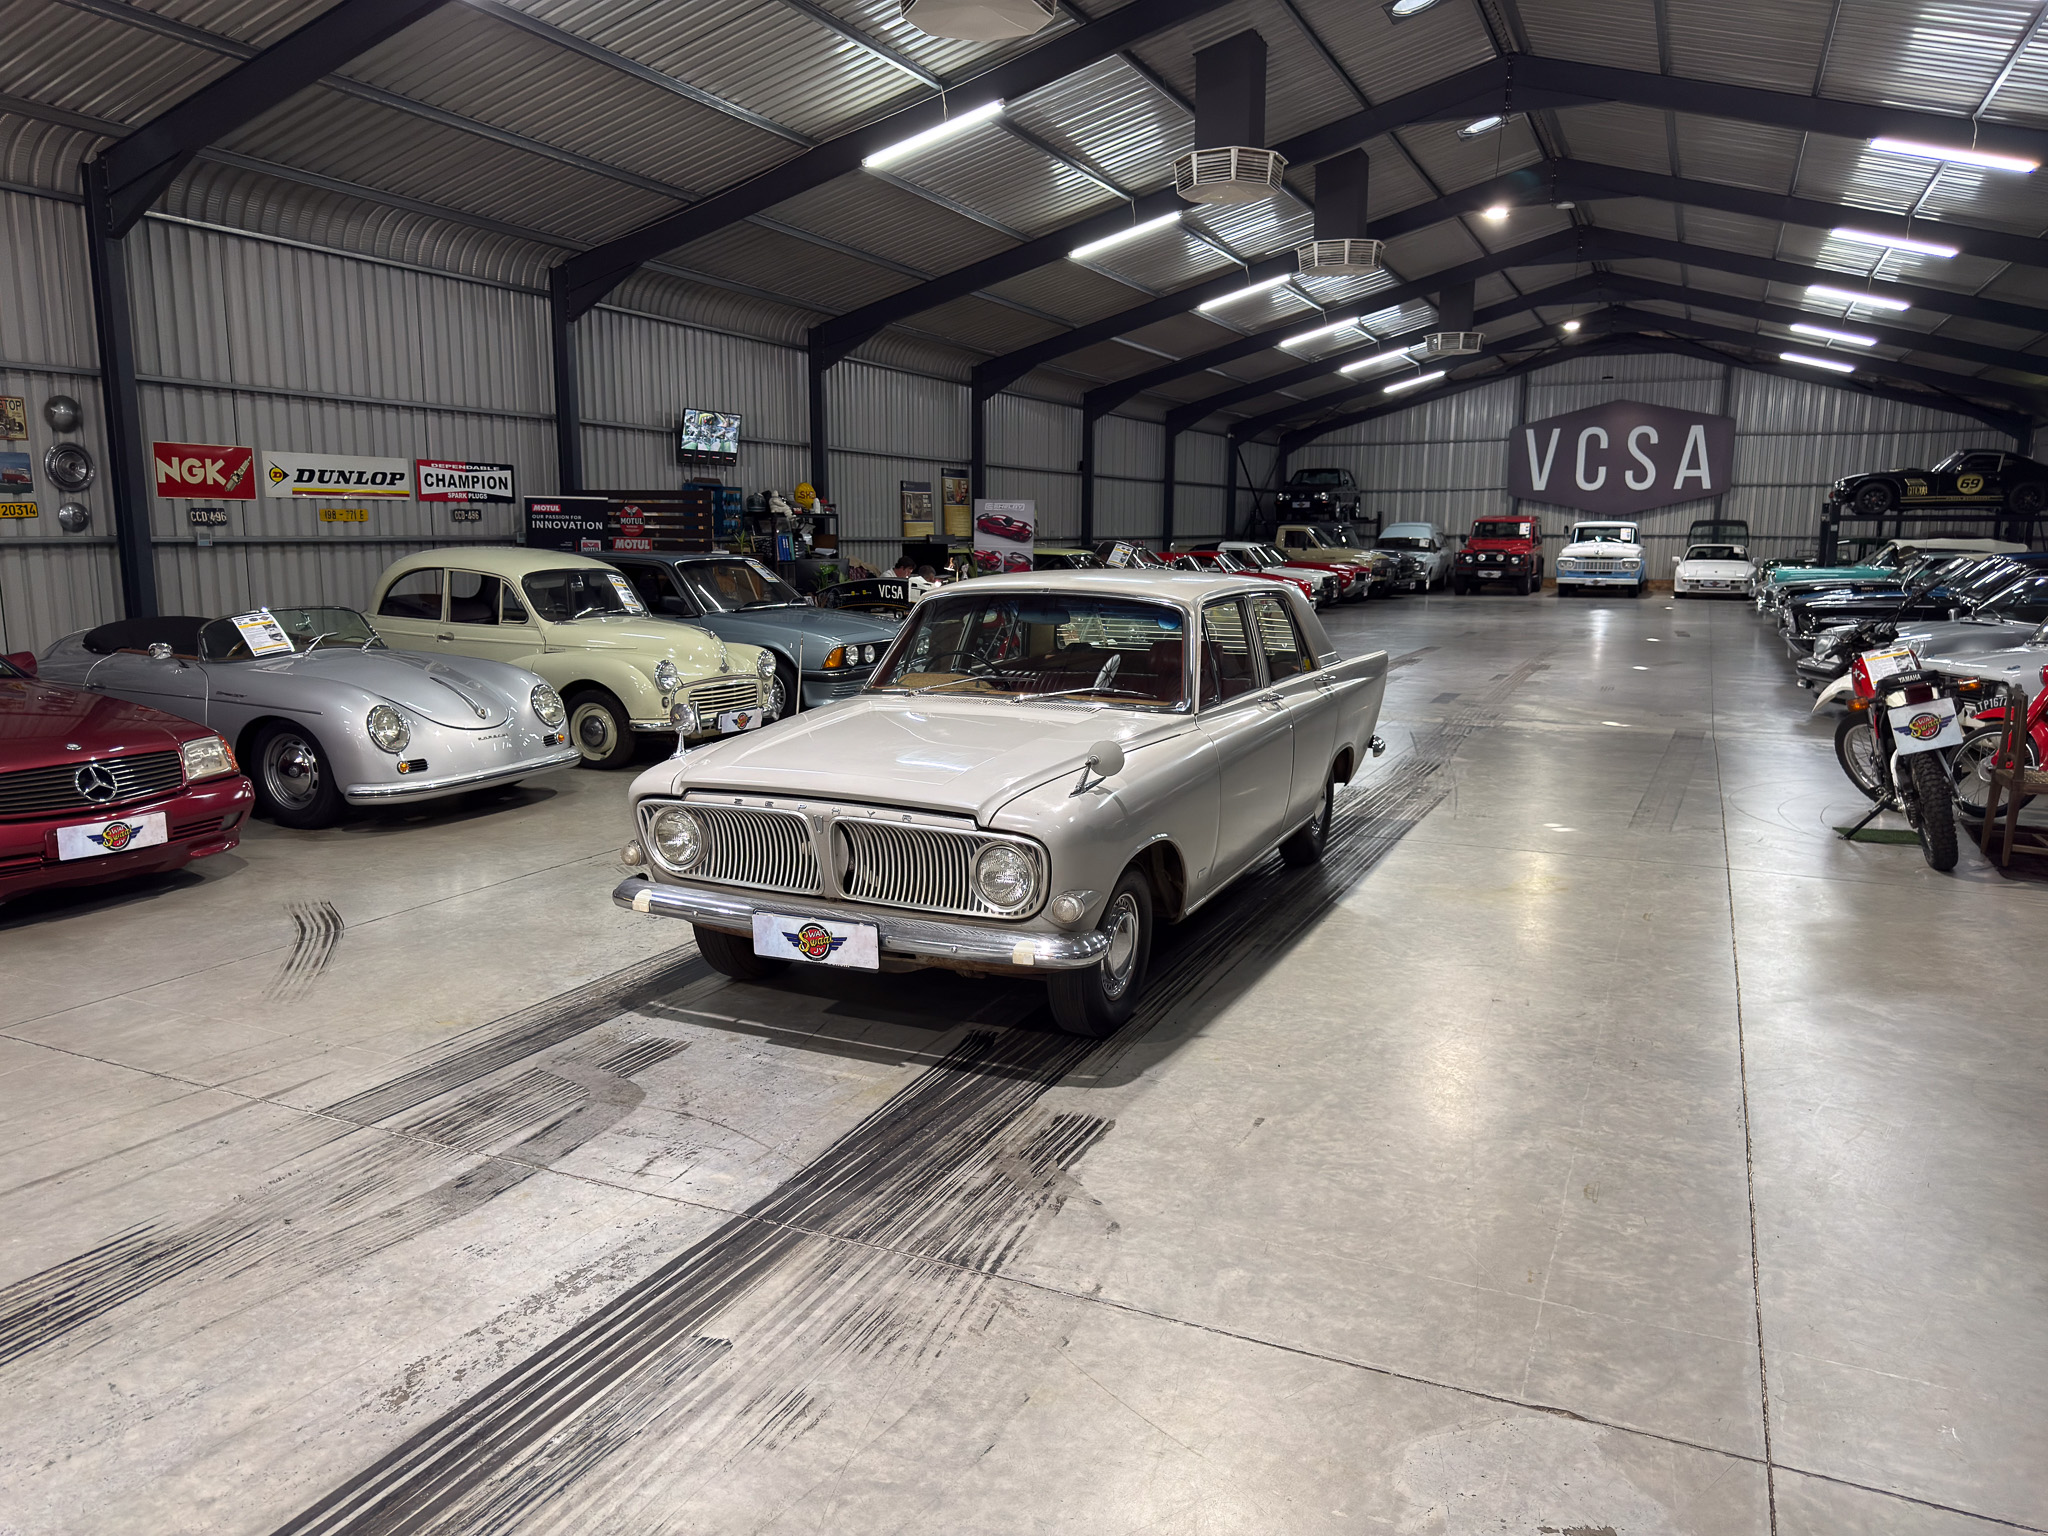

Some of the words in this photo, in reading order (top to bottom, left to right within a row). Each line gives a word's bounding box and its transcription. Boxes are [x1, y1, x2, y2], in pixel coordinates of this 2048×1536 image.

[1526, 425, 1711, 491] VCSA
[156, 457, 227, 486] NGK
[431, 463, 500, 471] DEPENDABLE
[294, 468, 405, 486] DUNLOP
[424, 472, 508, 490] CHAMPION
[1960, 479, 1980, 488] 69
[1, 504, 37, 516] 20314
[532, 520, 603, 530] INNOVATION
[620, 517, 643, 525] MOTUL
[615, 539, 650, 550] MOTUL
[878, 584, 903, 599] VCSA
[1853, 669, 1865, 680] XT
[1898, 674, 1921, 684] YAMAHA
[734, 798, 912, 823] ZEPHYR
